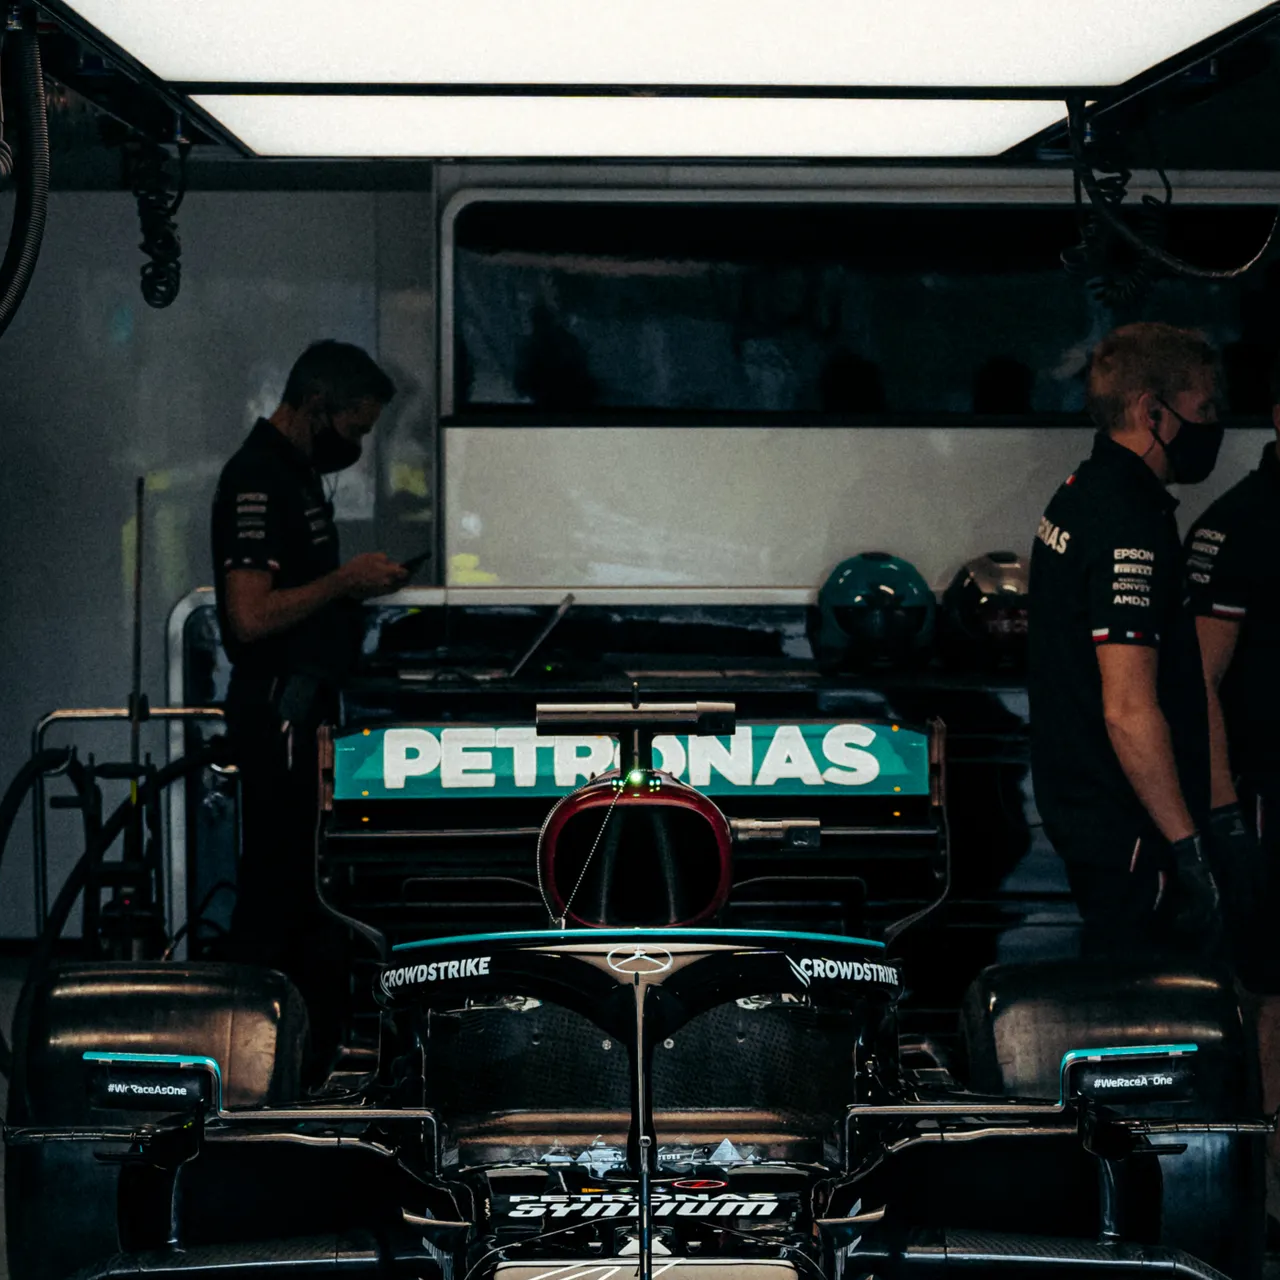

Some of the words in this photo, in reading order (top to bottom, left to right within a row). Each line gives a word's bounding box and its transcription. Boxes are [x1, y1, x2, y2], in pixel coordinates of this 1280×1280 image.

[1114, 548, 1154, 562] EPSON
[383, 724, 881, 789] PETRONAS
[382, 956, 491, 988] CROWDSTRIKE
[799, 957, 899, 986] CROWDSTRIKE
[1094, 1073, 1173, 1089] #WeRaceAOne
[509, 1193, 778, 1203] PETRONAS
[508, 1201, 780, 1218] SYNTIUM
